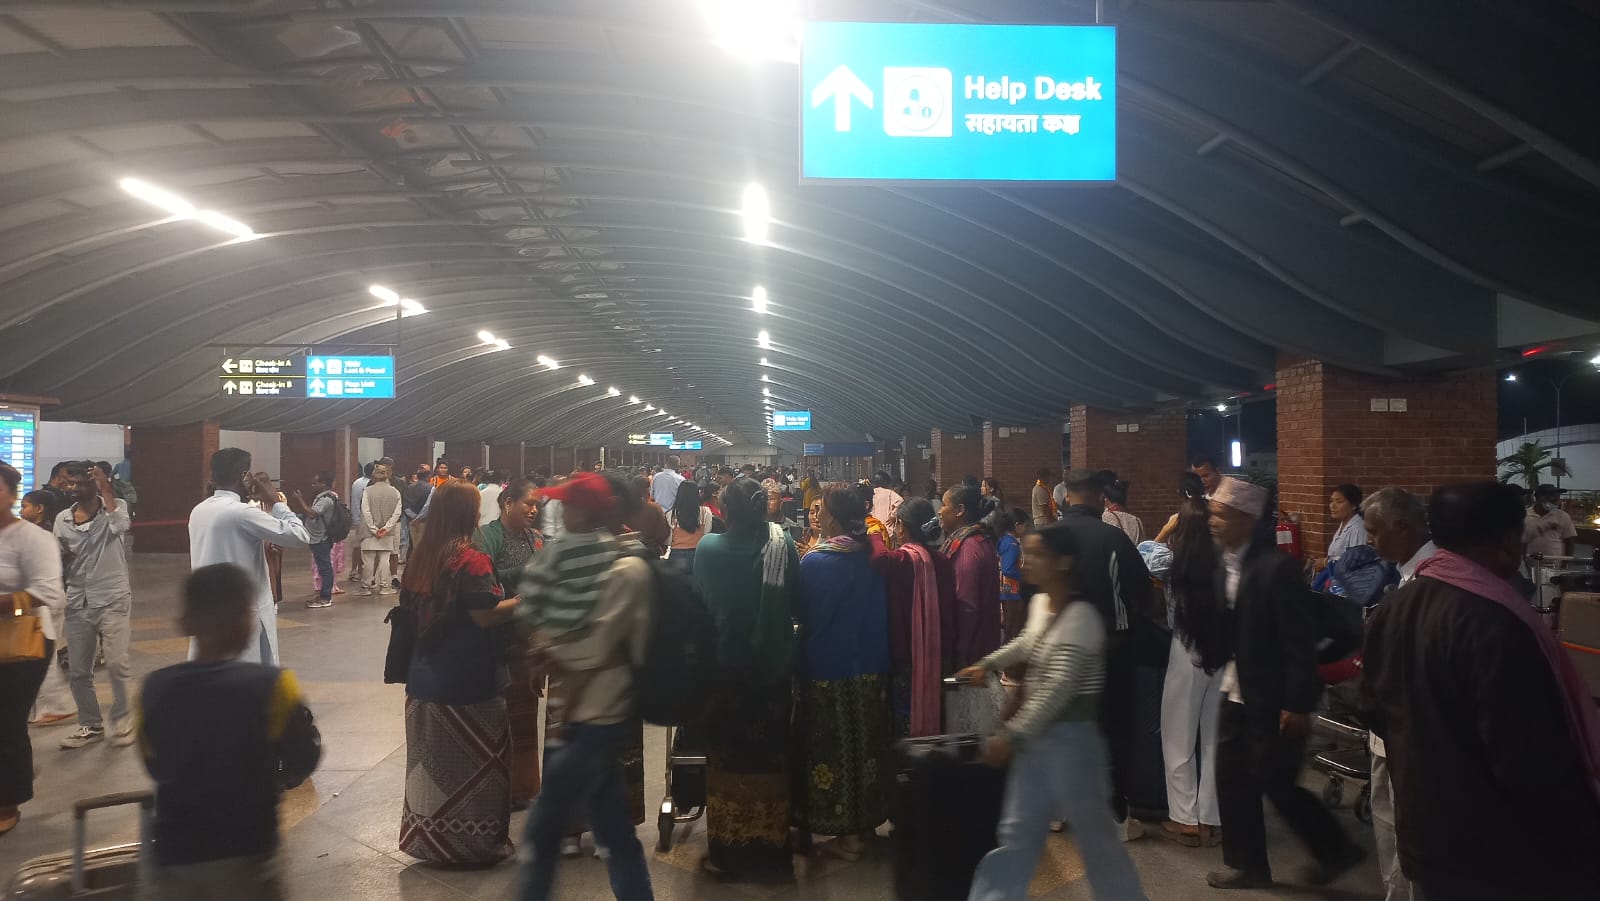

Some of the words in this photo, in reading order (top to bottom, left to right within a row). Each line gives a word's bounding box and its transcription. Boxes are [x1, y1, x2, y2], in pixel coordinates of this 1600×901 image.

[964, 75, 1027, 105] Help
[1034, 76, 1102, 100] Desk
[964, 114, 1039, 135] सहायता
